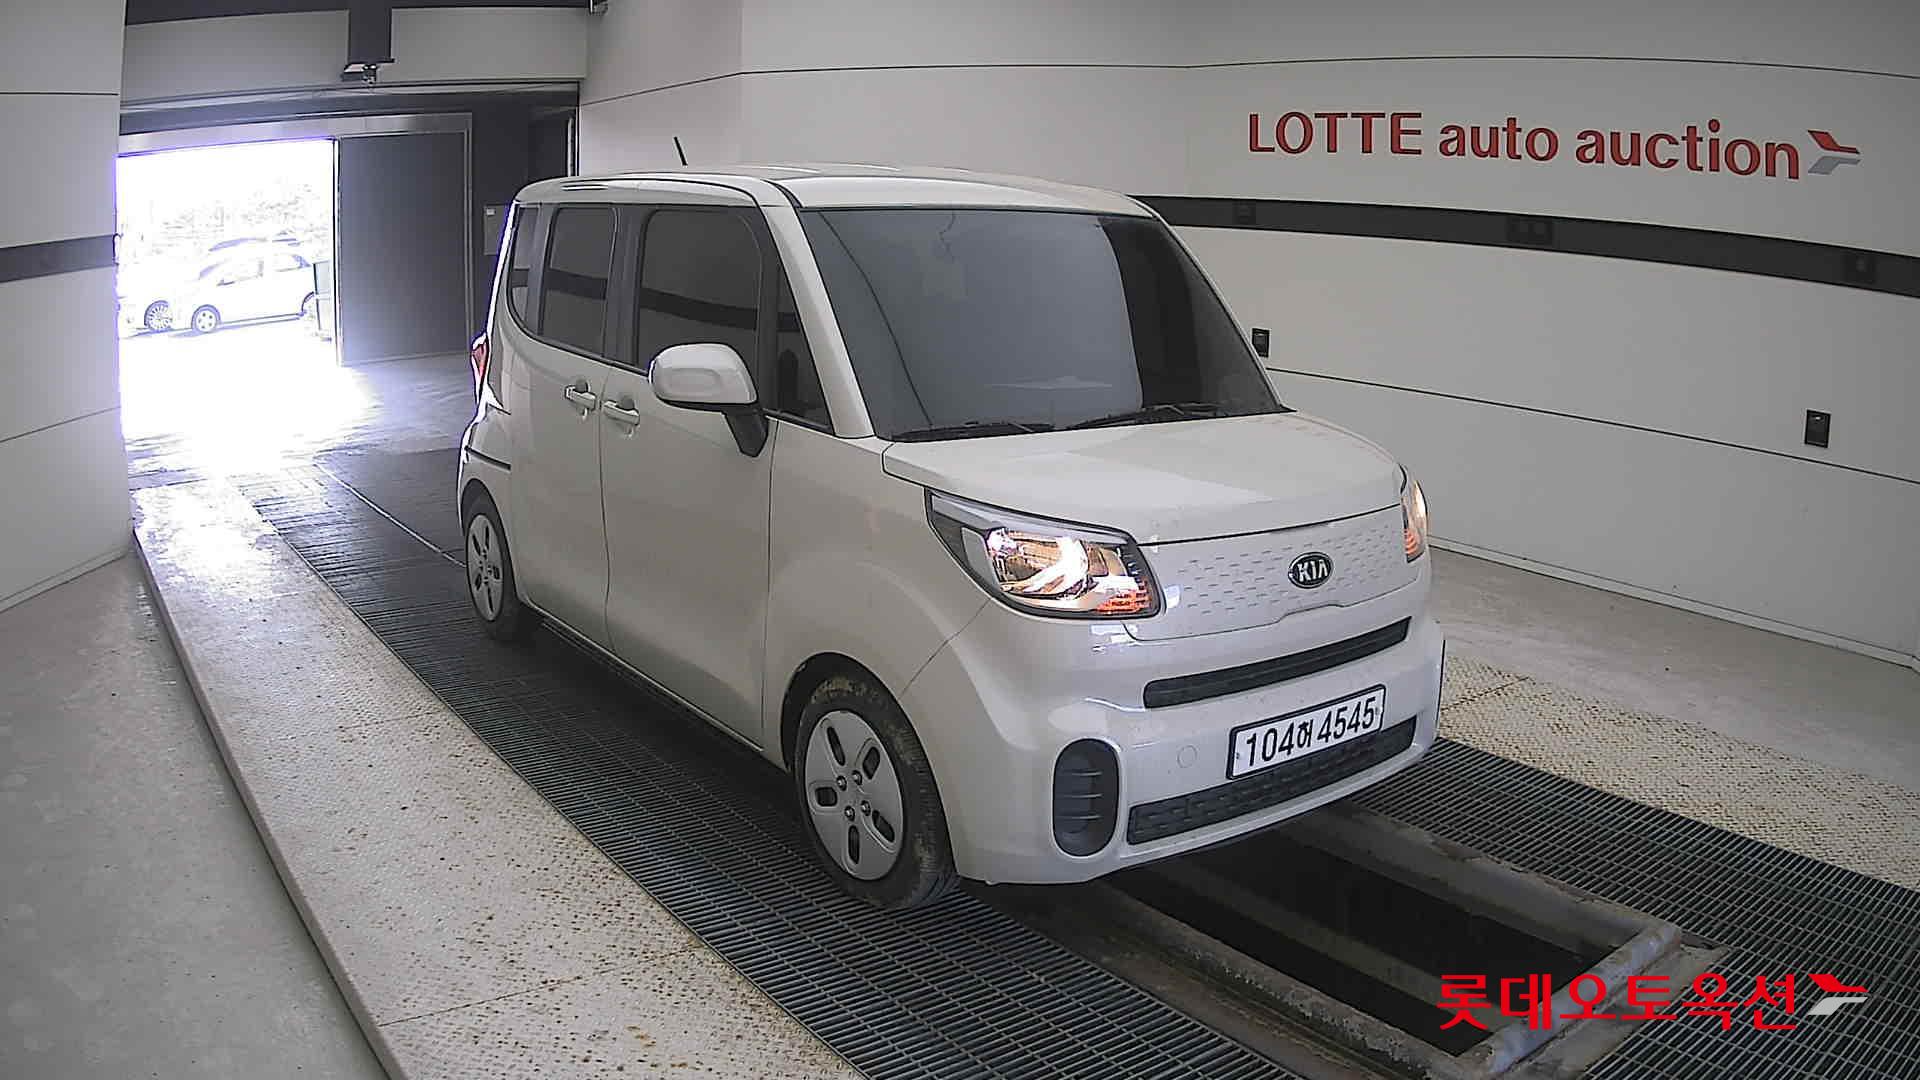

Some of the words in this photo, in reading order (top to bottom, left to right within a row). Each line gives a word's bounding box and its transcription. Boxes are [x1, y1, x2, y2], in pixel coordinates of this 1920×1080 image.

[1248, 111, 1423, 155] LOTTE
[1438, 116, 1559, 161] auto
[1575, 118, 1801, 180] auction
[1297, 559, 1328, 582] KIA
[1316, 696, 1377, 744] 4545
